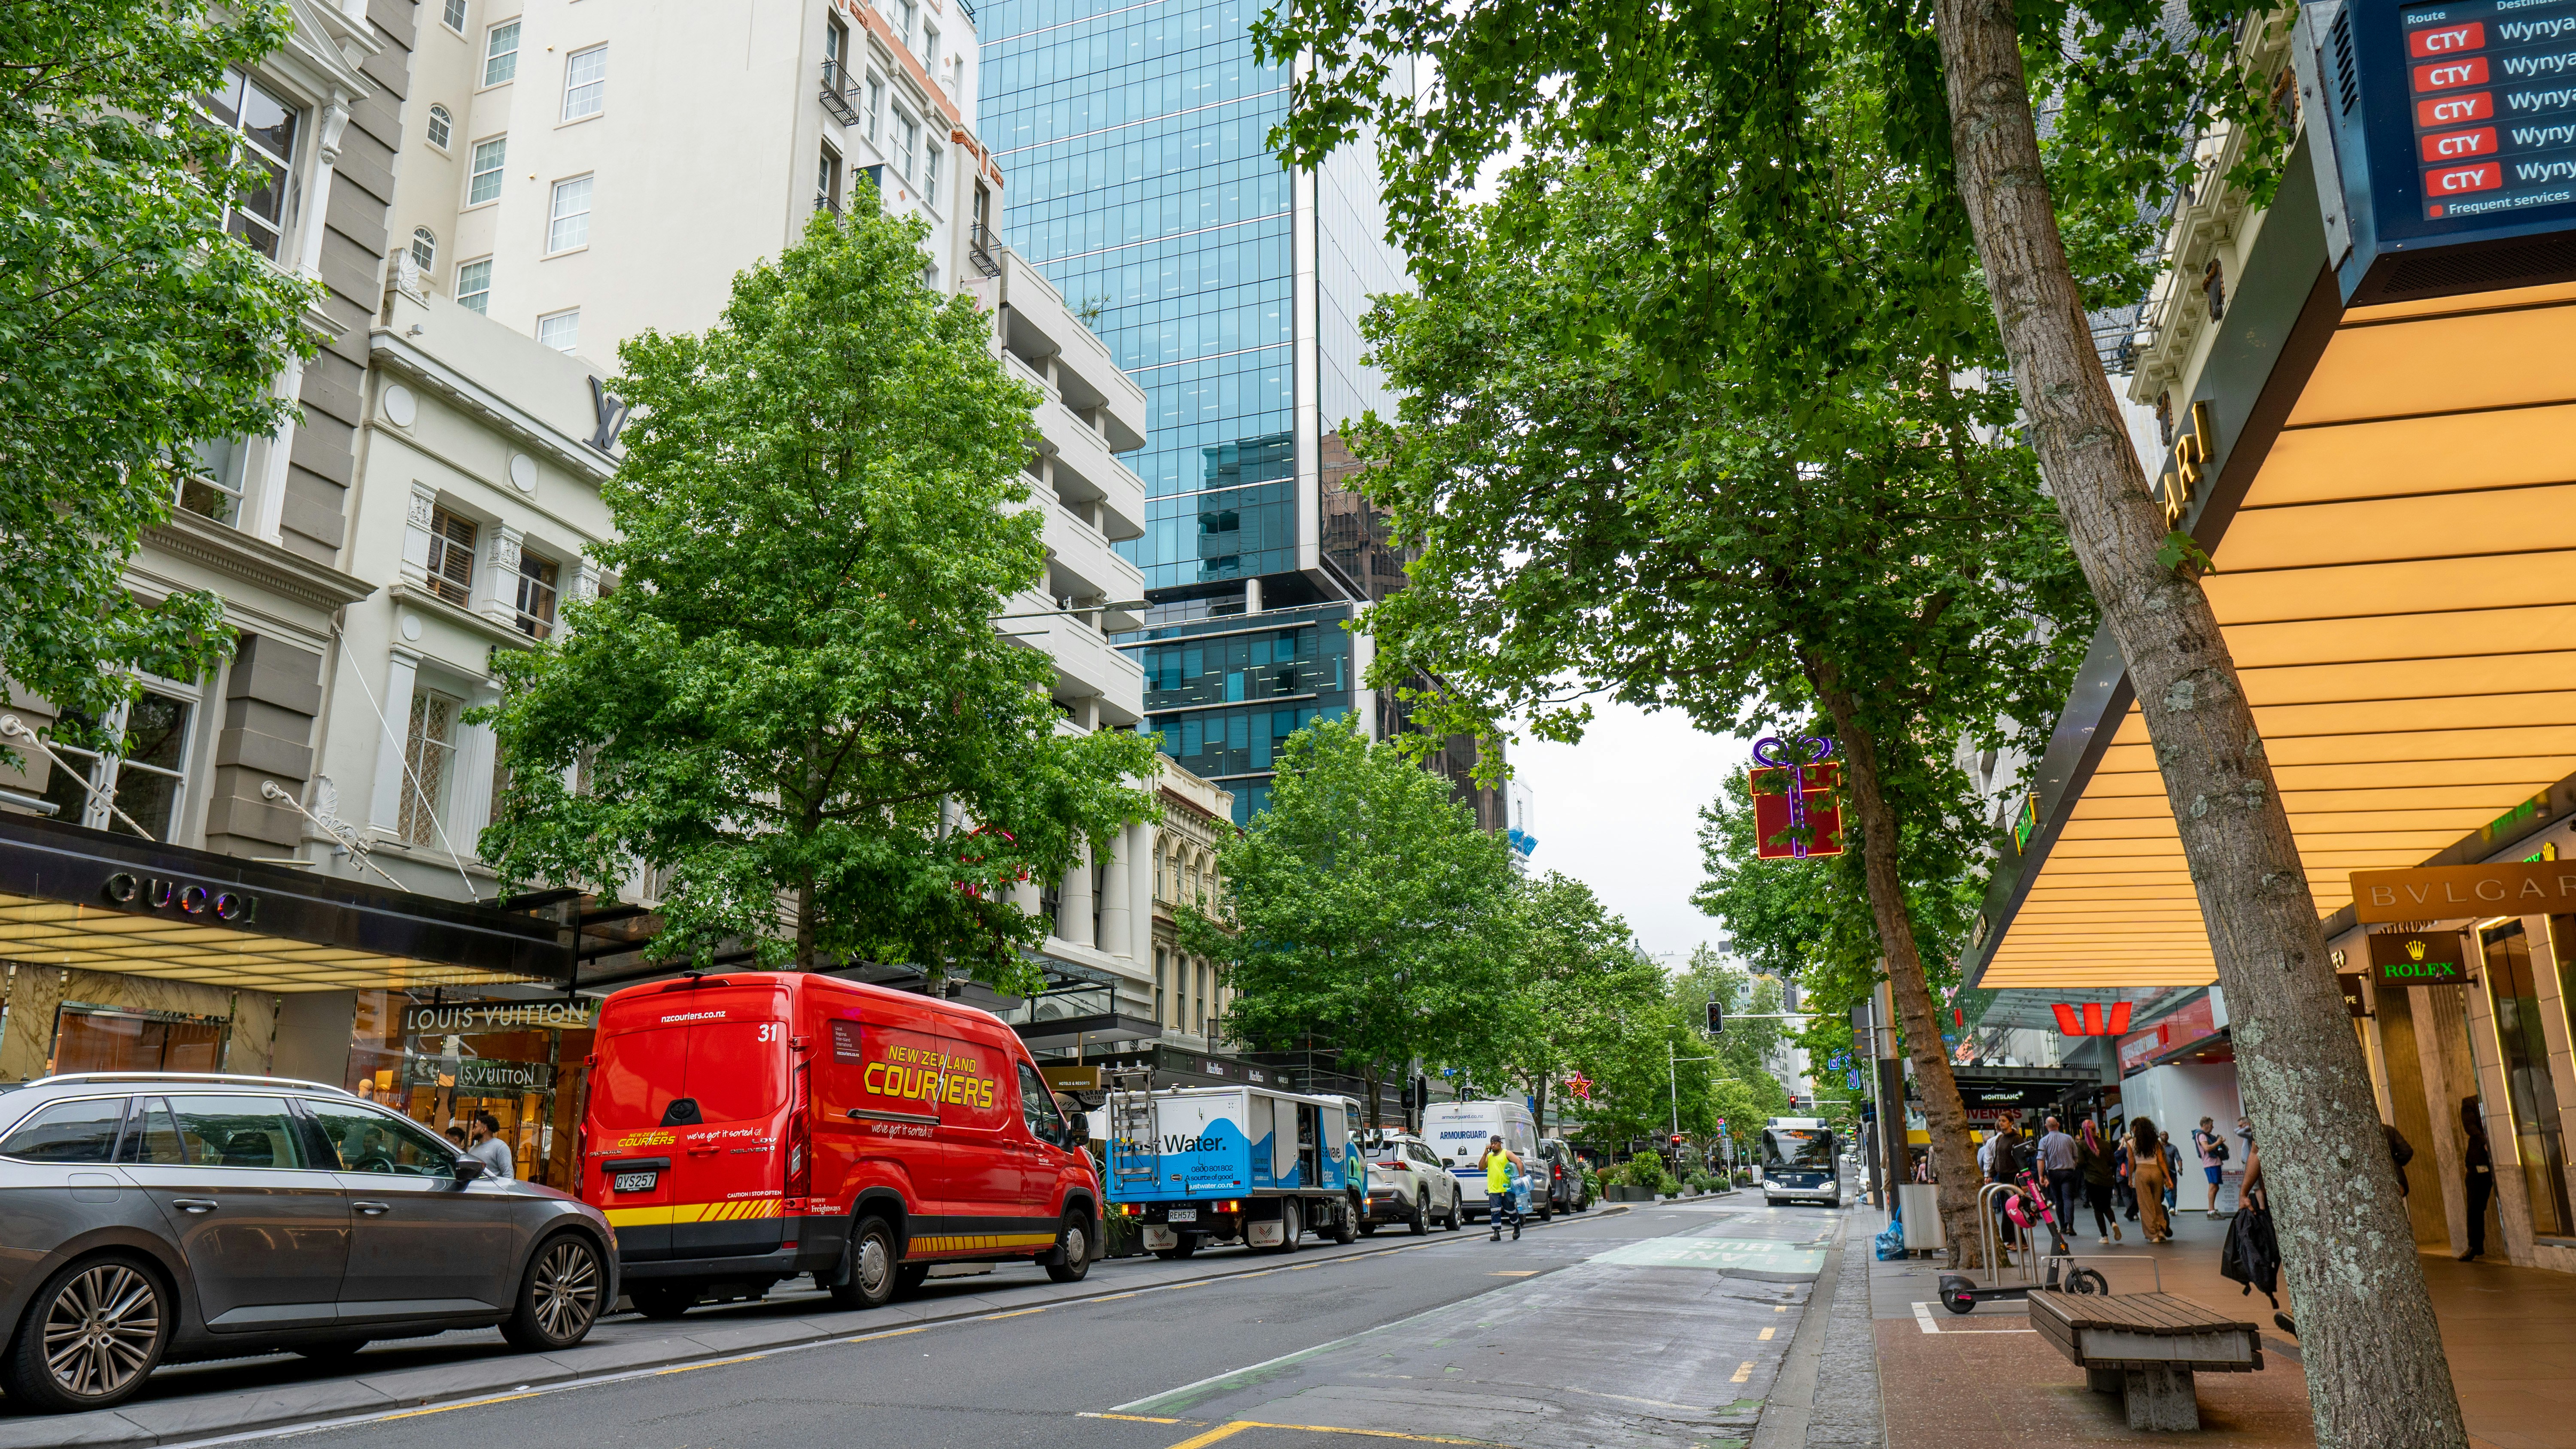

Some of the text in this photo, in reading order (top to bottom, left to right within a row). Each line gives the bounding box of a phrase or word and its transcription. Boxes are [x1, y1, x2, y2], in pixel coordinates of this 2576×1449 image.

[2407, 12, 2446, 24] Route
[2426, 30, 2468, 51] CTY
[2430, 64, 2472, 85] CTY
[2434, 100, 2476, 120] CTY
[2438, 134, 2480, 155] CTY
[2442, 169, 2485, 190] CTY
[2449, 190, 2570, 215] Frequent services
[109, 872, 259, 924] GUCCI
[2384, 962, 2456, 978] ROLEX
[407, 1002, 584, 1030] LOUIS VUITTON
[661, 1010, 726, 1023] nzcouriers.co.nz
[758, 1024, 777, 1042] 31
[887, 1045, 976, 1074] NEW ZEALAND
[477, 1065, 534, 1085] VUITTON
[1206, 1061, 1223, 1075] MaxMara
[1249, 1070, 1264, 1082] MaxMara
[1278, 1076, 1288, 1084] QUEST
[863, 1061, 994, 1109] COURIERS
[687, 1127, 753, 1142] we've got it sorted
[872, 1122, 927, 1140] we've got it sorted
[1440, 1130, 1487, 1140] ARMOURGUARD
[618, 1136, 676, 1147] COURIERS
[1163, 1134, 1227, 1153] Water.
[1328, 1147, 1341, 1158] wave.
[616, 1174, 655, 1188] QYS257
[1218, 1173, 1233, 1181] good
[1188, 1183, 1234, 1191] justwater.co.nz
[2030, 1183, 2042, 1202] Flamingo
[811, 1204, 841, 1215] Freightways
[1170, 1211, 1196, 1219] REH573
[1687, 1241, 1774, 1252] BUS
[1652, 1250, 1780, 1265] LANE
